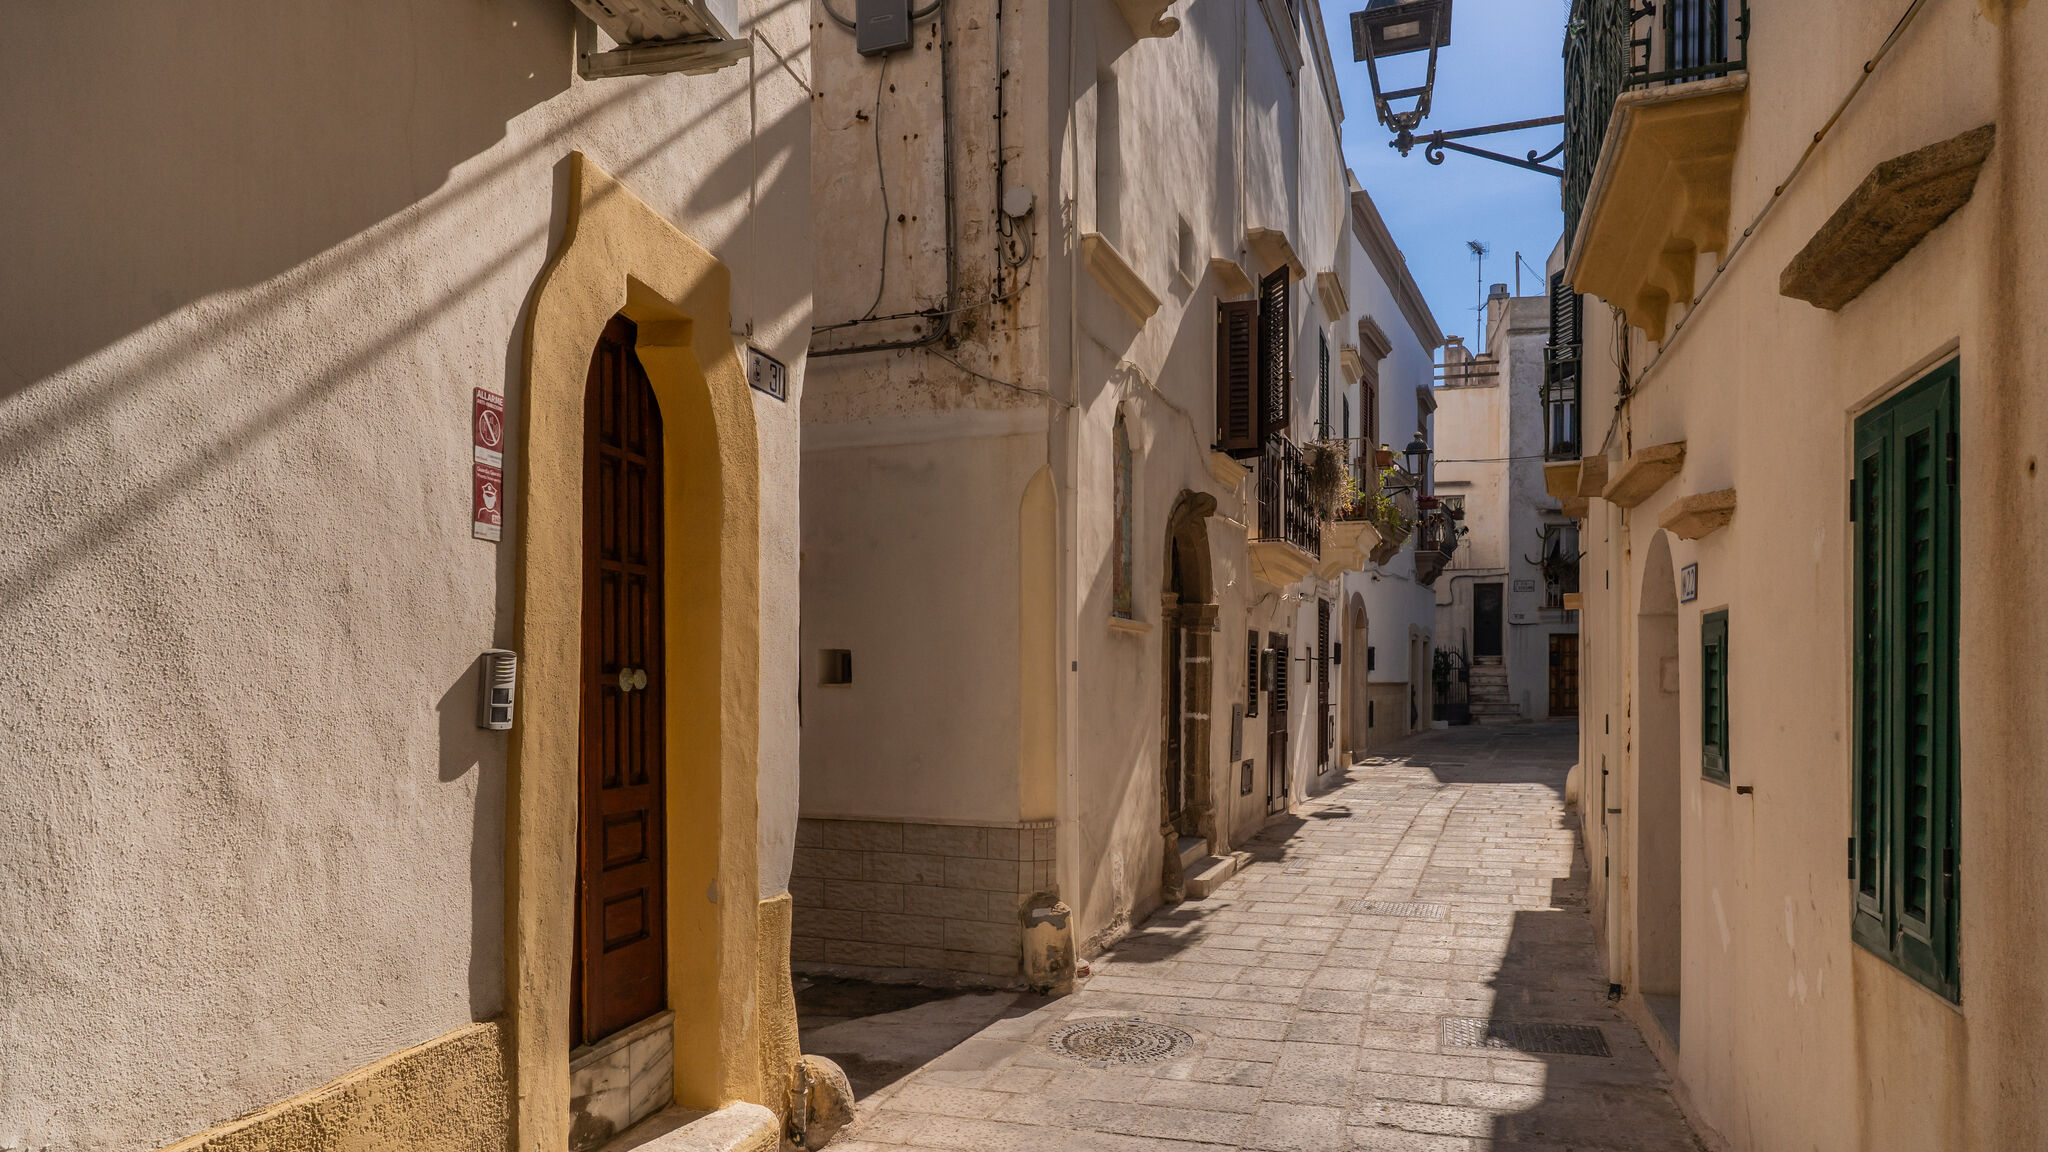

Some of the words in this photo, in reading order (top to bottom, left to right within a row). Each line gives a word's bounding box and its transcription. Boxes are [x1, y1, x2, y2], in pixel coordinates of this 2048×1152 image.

[769, 363, 781, 396] 31
[476, 389, 504, 407] ALLARME
[1686, 568, 1695, 597] 22
